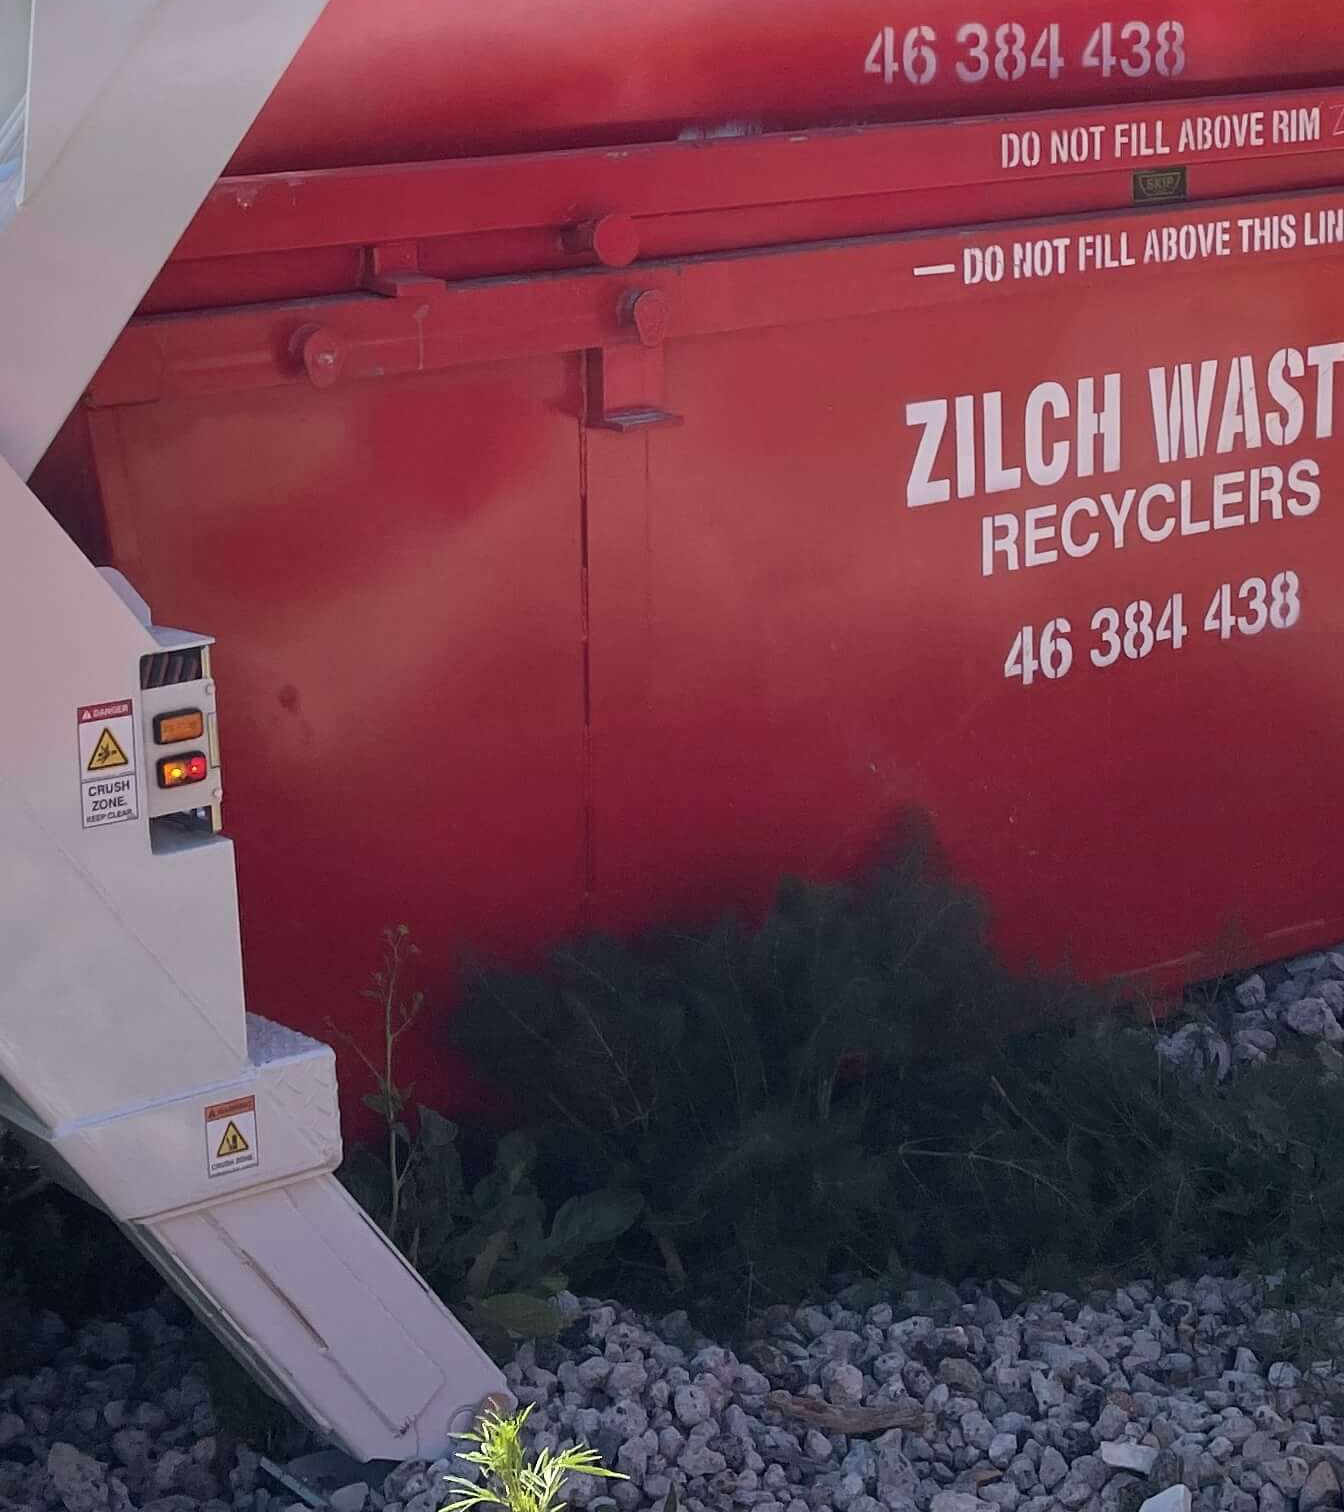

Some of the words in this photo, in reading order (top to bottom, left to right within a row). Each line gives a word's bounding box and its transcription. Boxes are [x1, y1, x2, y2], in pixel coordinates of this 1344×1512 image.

[864, 25, 936, 85] 46
[956, 22, 1064, 82] 384
[1082, 20, 1186, 79] 438
[1000, 131, 1041, 169] DO
[1049, 126, 1105, 165] NOT
[1114, 120, 1170, 159] FILL
[1178, 111, 1264, 153] ABOVE
[1272, 107, 1321, 144] RIM
[963, 245, 1004, 284] DO
[1013, 237, 1071, 279] NOT
[1078, 231, 1135, 271] FILL
[1143, 220, 1230, 264] ABOVE
[1237, 213, 1296, 253] THIS
[905, 373, 1121, 508] ZILCH
[982, 459, 1321, 576] RECYCLERS
[1003, 617, 1073, 685] 46
[1089, 593, 1187, 667] 384
[1204, 571, 1300, 640] 438
[88, 780, 130, 797] CRUSH
